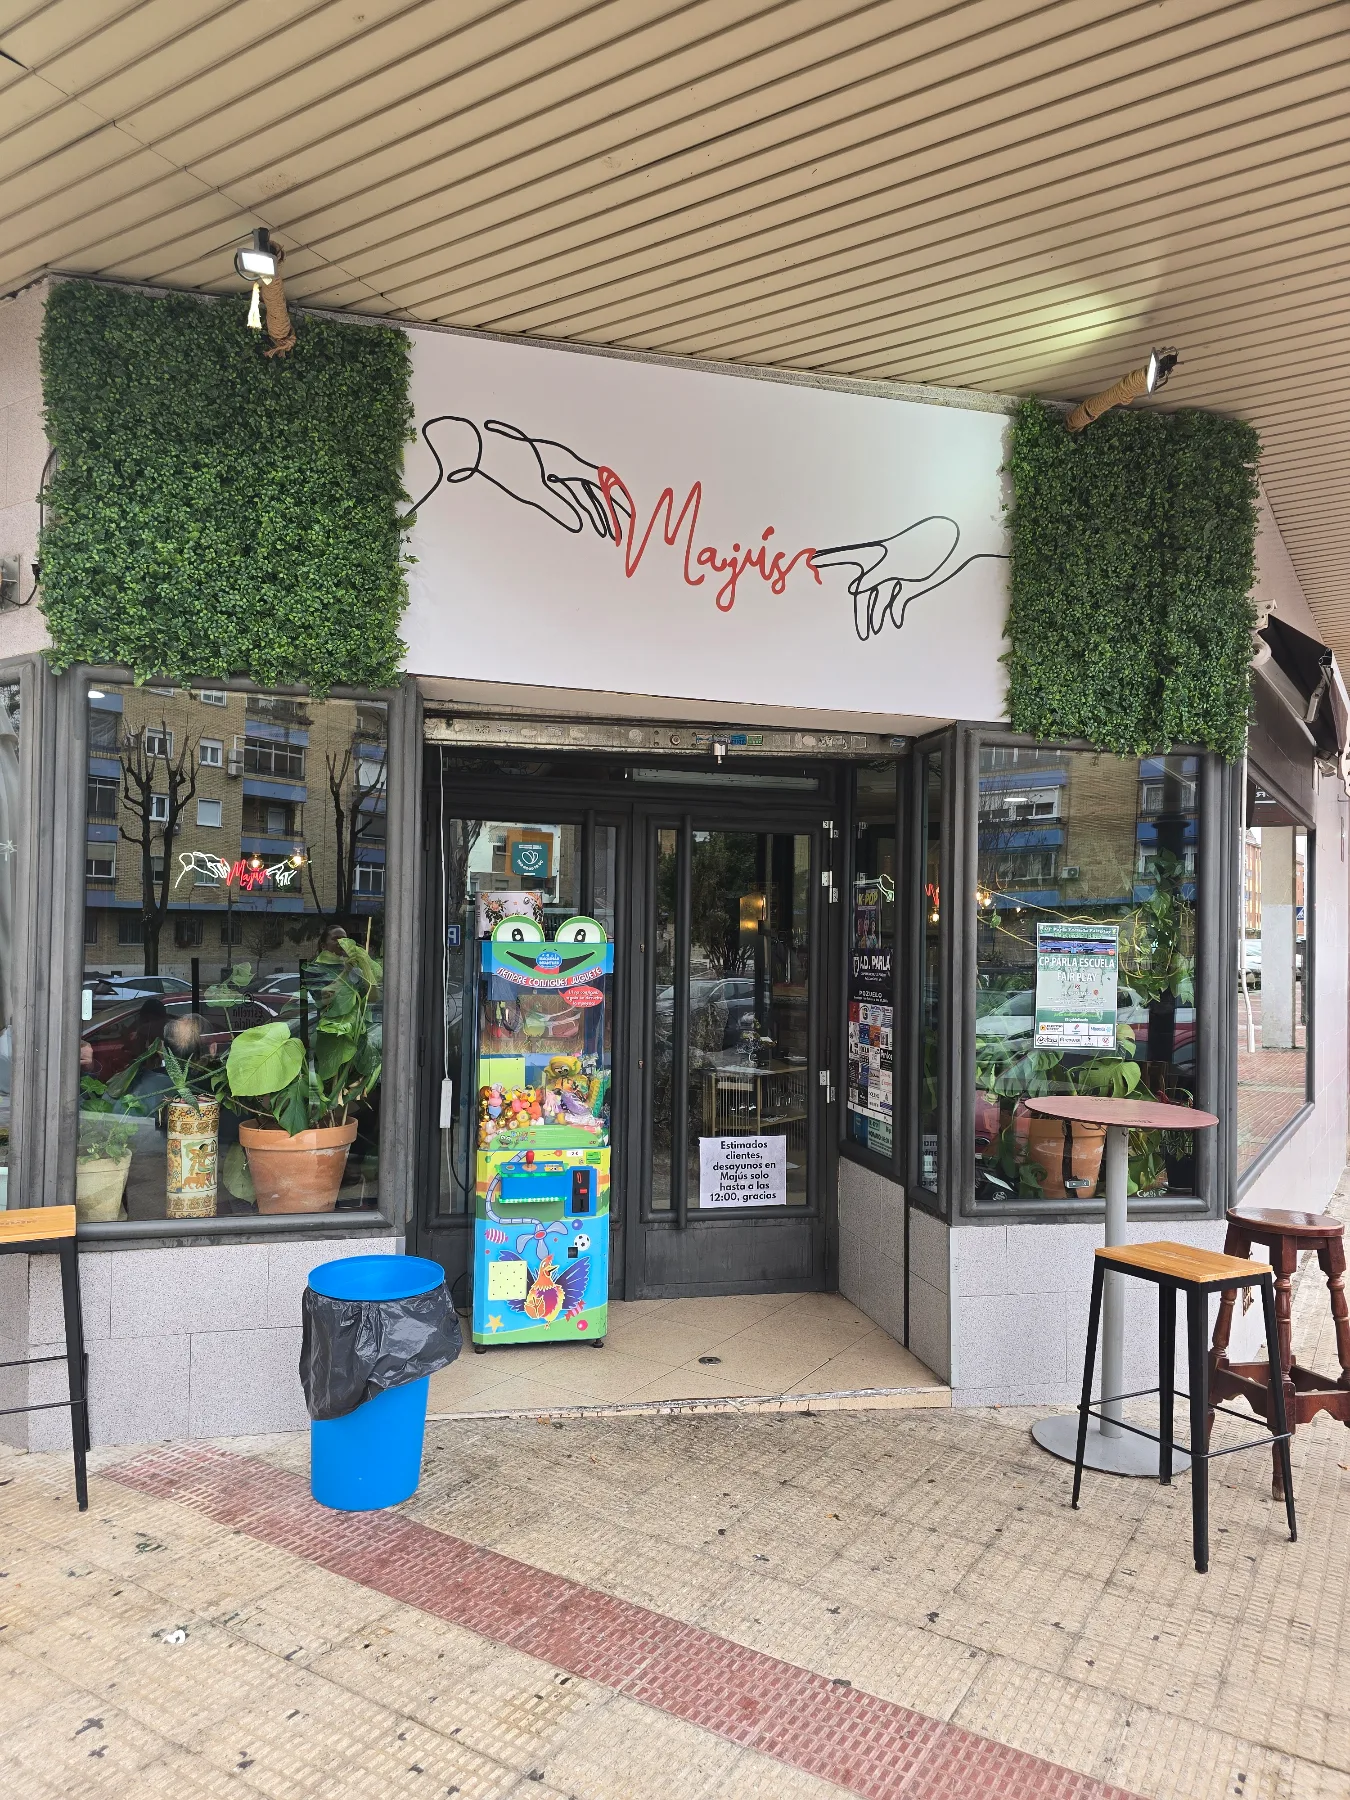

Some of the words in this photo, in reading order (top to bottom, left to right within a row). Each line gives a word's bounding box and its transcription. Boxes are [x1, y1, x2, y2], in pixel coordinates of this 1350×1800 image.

[1051, 957, 1078, 967] PARLA
[1079, 958, 1115, 968] ESCUELA
[496, 967, 527, 985] SIEMPRE
[528, 977, 569, 988] CONSIGUES
[570, 967, 602, 986] JUGUETE
[1057, 972, 1075, 982] FAIR
[1077, 972, 1097, 982] PLAY
[720, 1139, 768, 1150] Estimados
[725, 1151, 763, 1160] clientes,
[712, 1162, 763, 1173] desayunos
[720, 1171, 748, 1182] Majús
[750, 1170, 769, 1180] solo
[719, 1182, 746, 1191] hasta
[756, 1181, 770, 1190] las
[709, 1192, 740, 1202] 12:00,
[742, 1190, 777, 1203] gracias
